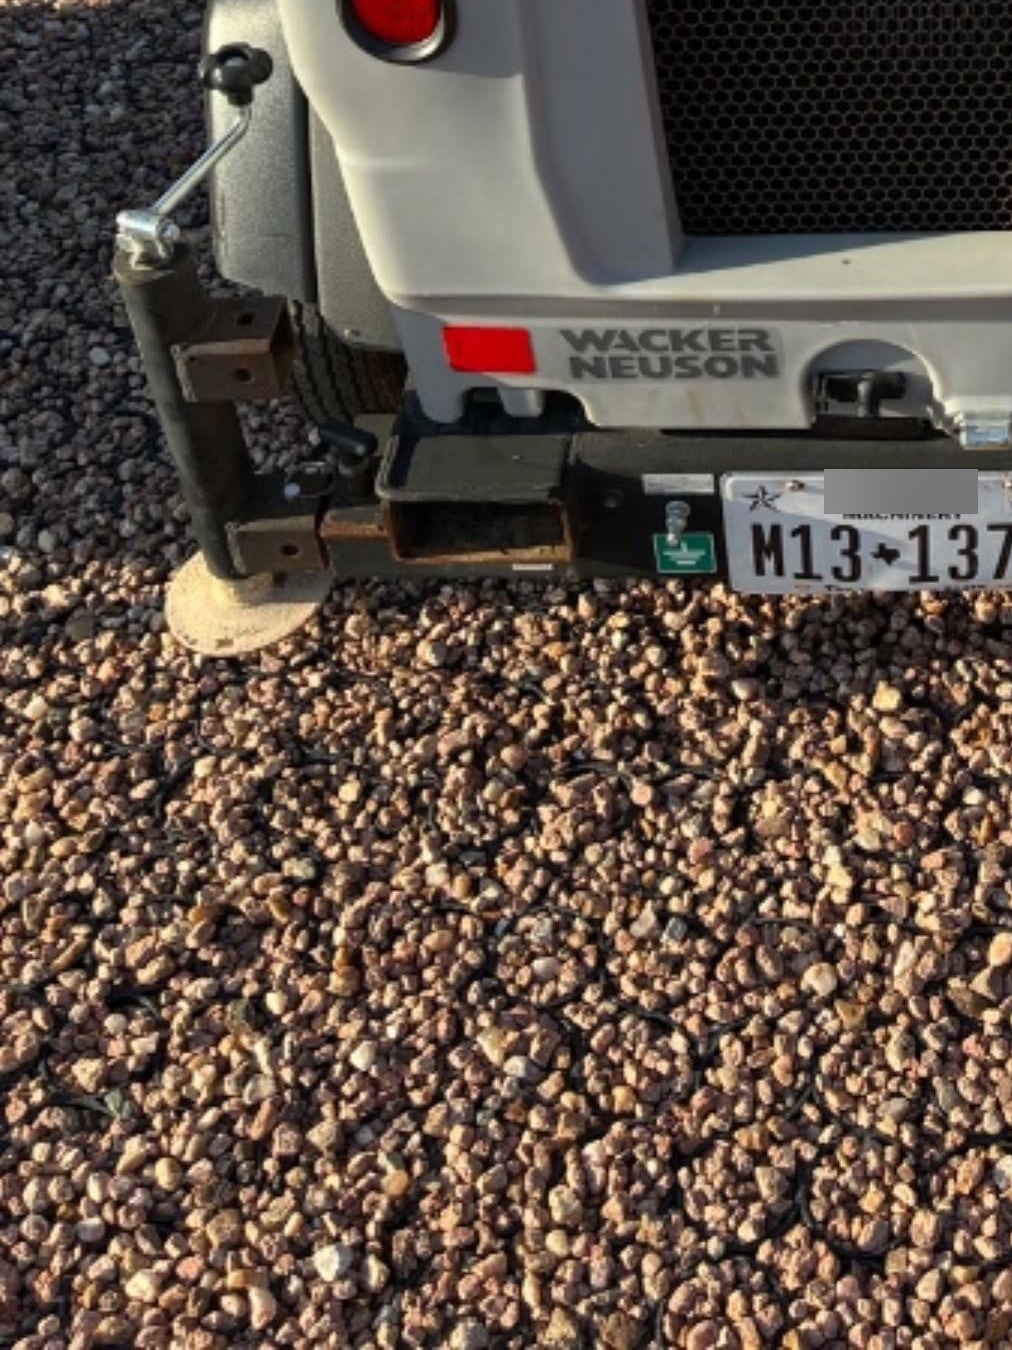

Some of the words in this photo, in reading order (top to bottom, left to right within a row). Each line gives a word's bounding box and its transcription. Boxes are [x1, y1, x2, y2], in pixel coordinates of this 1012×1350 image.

[559, 328, 776, 353] WACKER
[568, 354, 779, 379] NEUSON
[750, 522, 862, 583] M13
